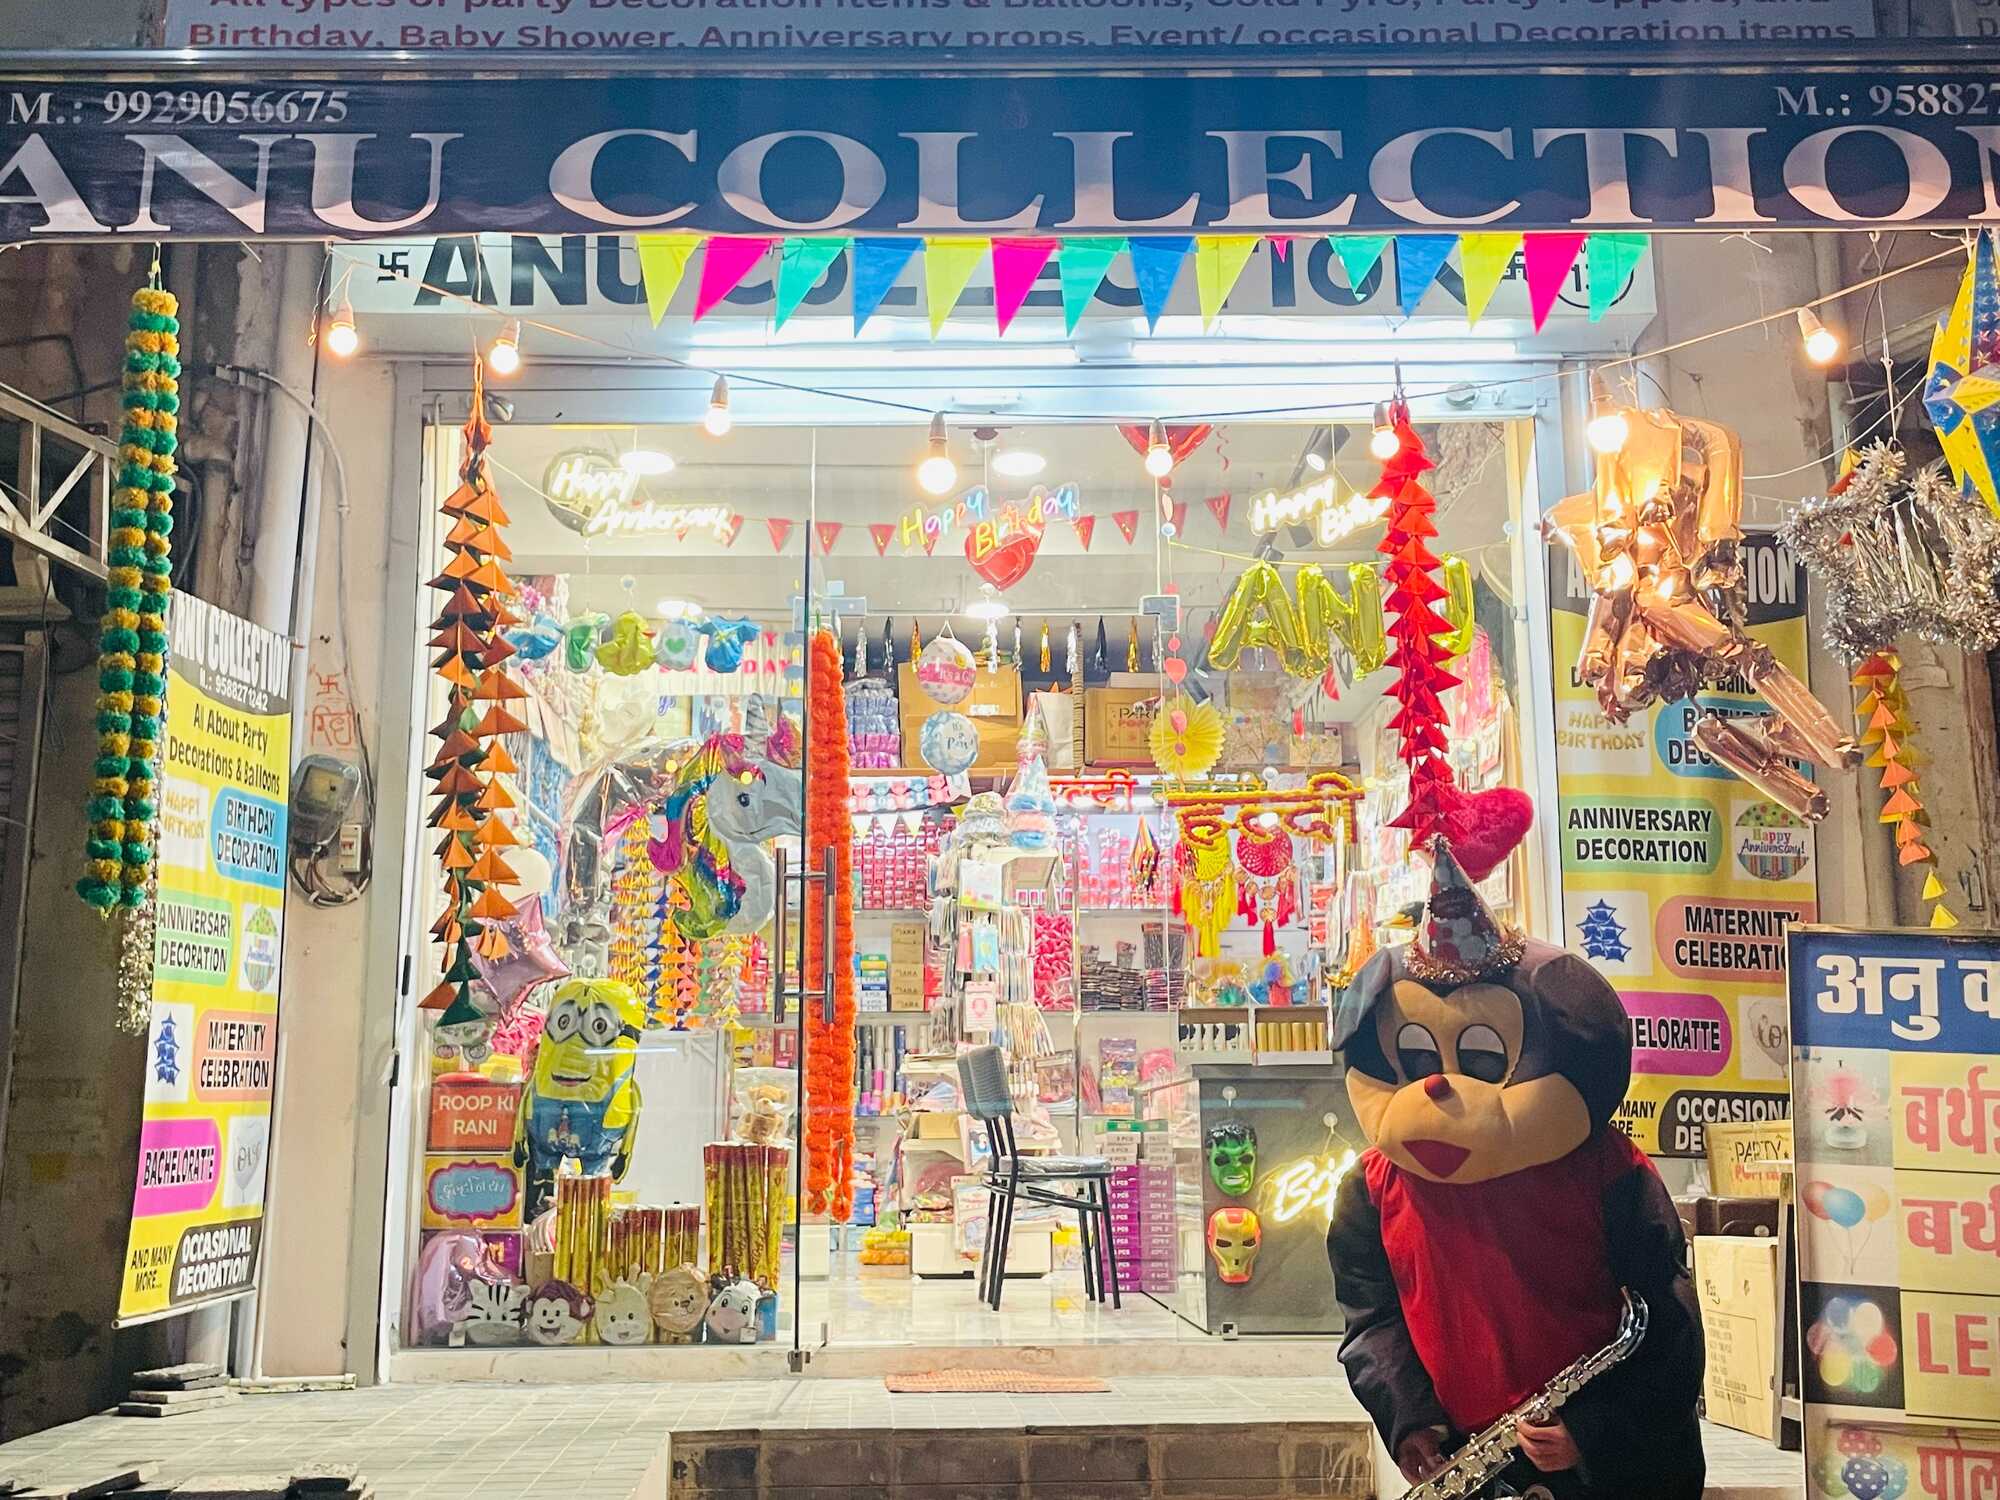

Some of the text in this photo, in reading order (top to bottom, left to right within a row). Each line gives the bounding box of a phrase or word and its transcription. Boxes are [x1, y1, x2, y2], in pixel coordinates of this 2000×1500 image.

[401, 24, 505, 48] Baby
[701, 25, 951, 48] Anniversary
[1257, 22, 1478, 45] occasional
[1496, 21, 1725, 43] Decoration
[1741, 21, 1855, 40] items
[102, 91, 349, 124] 9929056675
[0, 124, 2000, 233] ANU COLLECTIO
[208, 604, 291, 700] COLLECTION
[215, 675, 269, 713] 9588271242
[207, 709, 241, 742] About
[242, 718, 269, 755] Party
[169, 735, 233, 780] Decorations
[226, 799, 275, 838] BIRTHDAY
[1568, 808, 1712, 833] ANNIVERSARY
[1576, 838, 1708, 863] DECORATION
[1753, 828, 1792, 844] Happy
[217, 832, 279, 875] DECORATION
[158, 903, 231, 939] ANNIVERSARY
[160, 938, 227, 972] DECORATION
[1675, 939, 1785, 971] CELEBRATI
[1816, 954, 1945, 1041] अनु
[1630, 1016, 1721, 1051] ELORATTE
[199, 1058, 270, 1088] CELEBRATION
[440, 1096, 514, 1111] ROOP KI
[1619, 1100, 1657, 1119] MANY
[1676, 1096, 1792, 1123] OCCASION
[453, 1120, 497, 1134] RANI
[131, 1249, 150, 1270] AND
[181, 1226, 252, 1264] OCCASIONAL
[176, 1254, 251, 1297] DECORATION
[1916, 1311, 2000, 1377] LE
